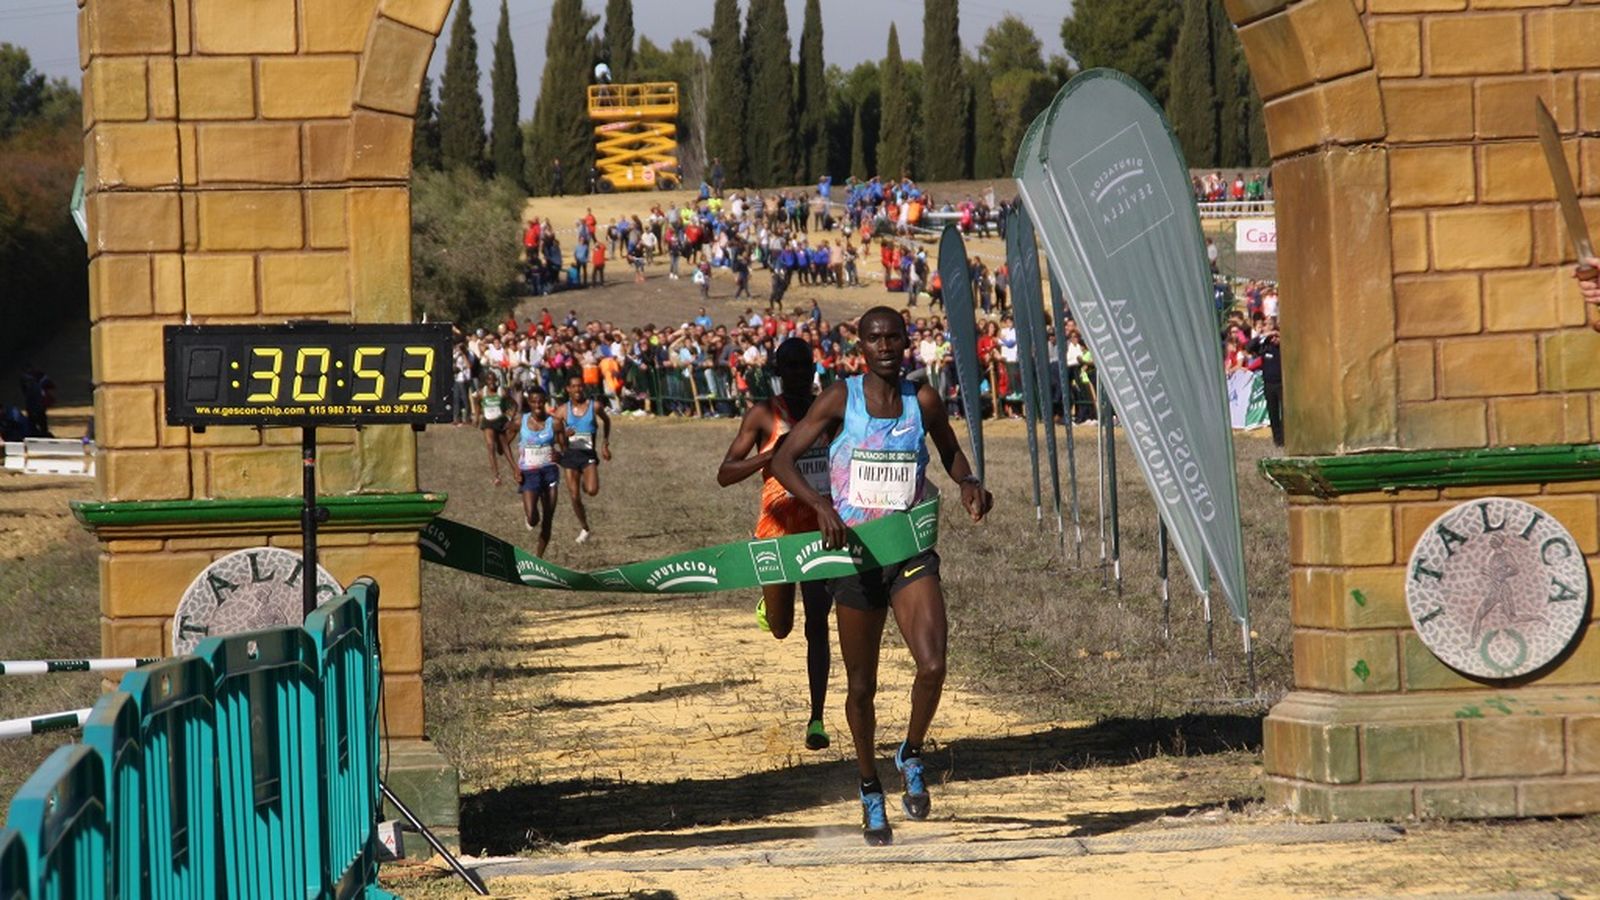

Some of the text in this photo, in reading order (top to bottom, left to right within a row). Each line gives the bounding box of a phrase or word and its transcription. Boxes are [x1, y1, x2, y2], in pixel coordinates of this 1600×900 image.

[1246, 228, 1277, 243] Caz
[309, 405, 326, 415] 615
[346, 405, 362, 414] 784
[411, 404, 428, 413] 452
[646, 561, 717, 586] DIPUTACION
[1413, 503, 1578, 627] ITALICA
